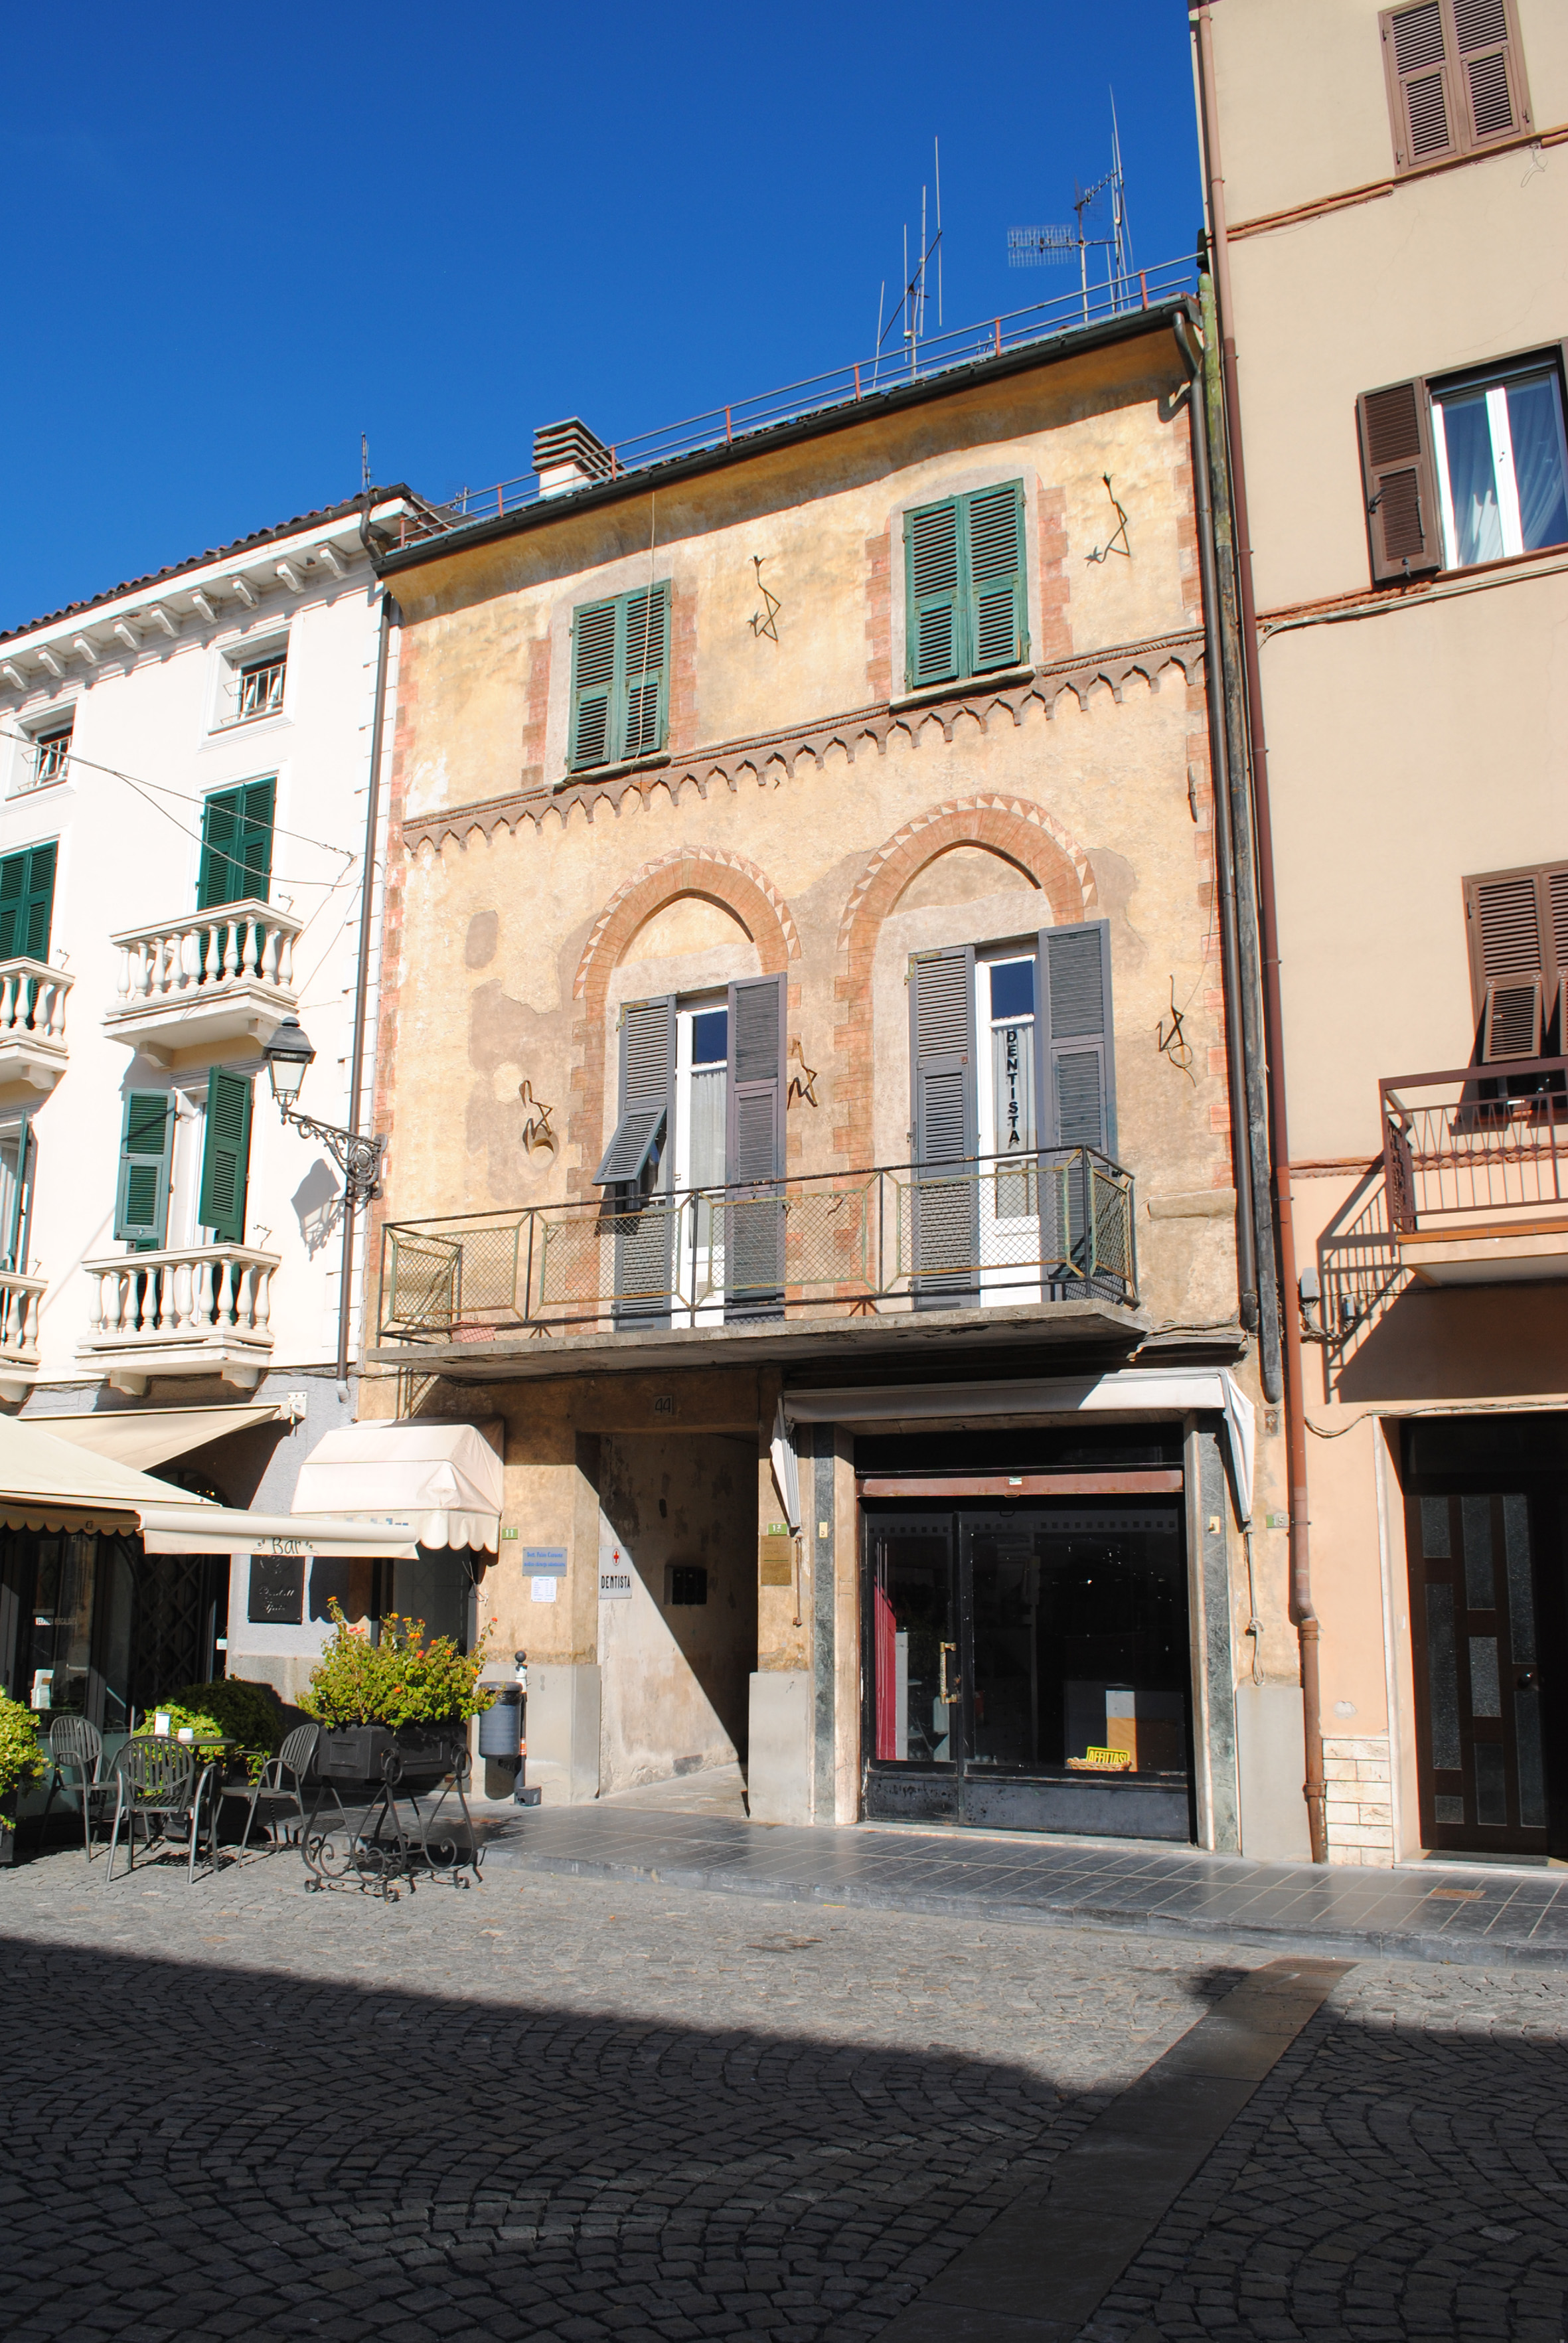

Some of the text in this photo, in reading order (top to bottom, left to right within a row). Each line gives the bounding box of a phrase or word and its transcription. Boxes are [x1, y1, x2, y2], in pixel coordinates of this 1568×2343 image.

[1006, 1030, 1020, 1143] DENTISTA
[655, 1397, 670, 1414] 44
[505, 1529, 514, 1538] 11
[271, 1537, 301, 1554] Bar
[601, 1575, 631, 1589] DENTISTA
[1089, 1749, 1128, 1765] AFFITTASI
